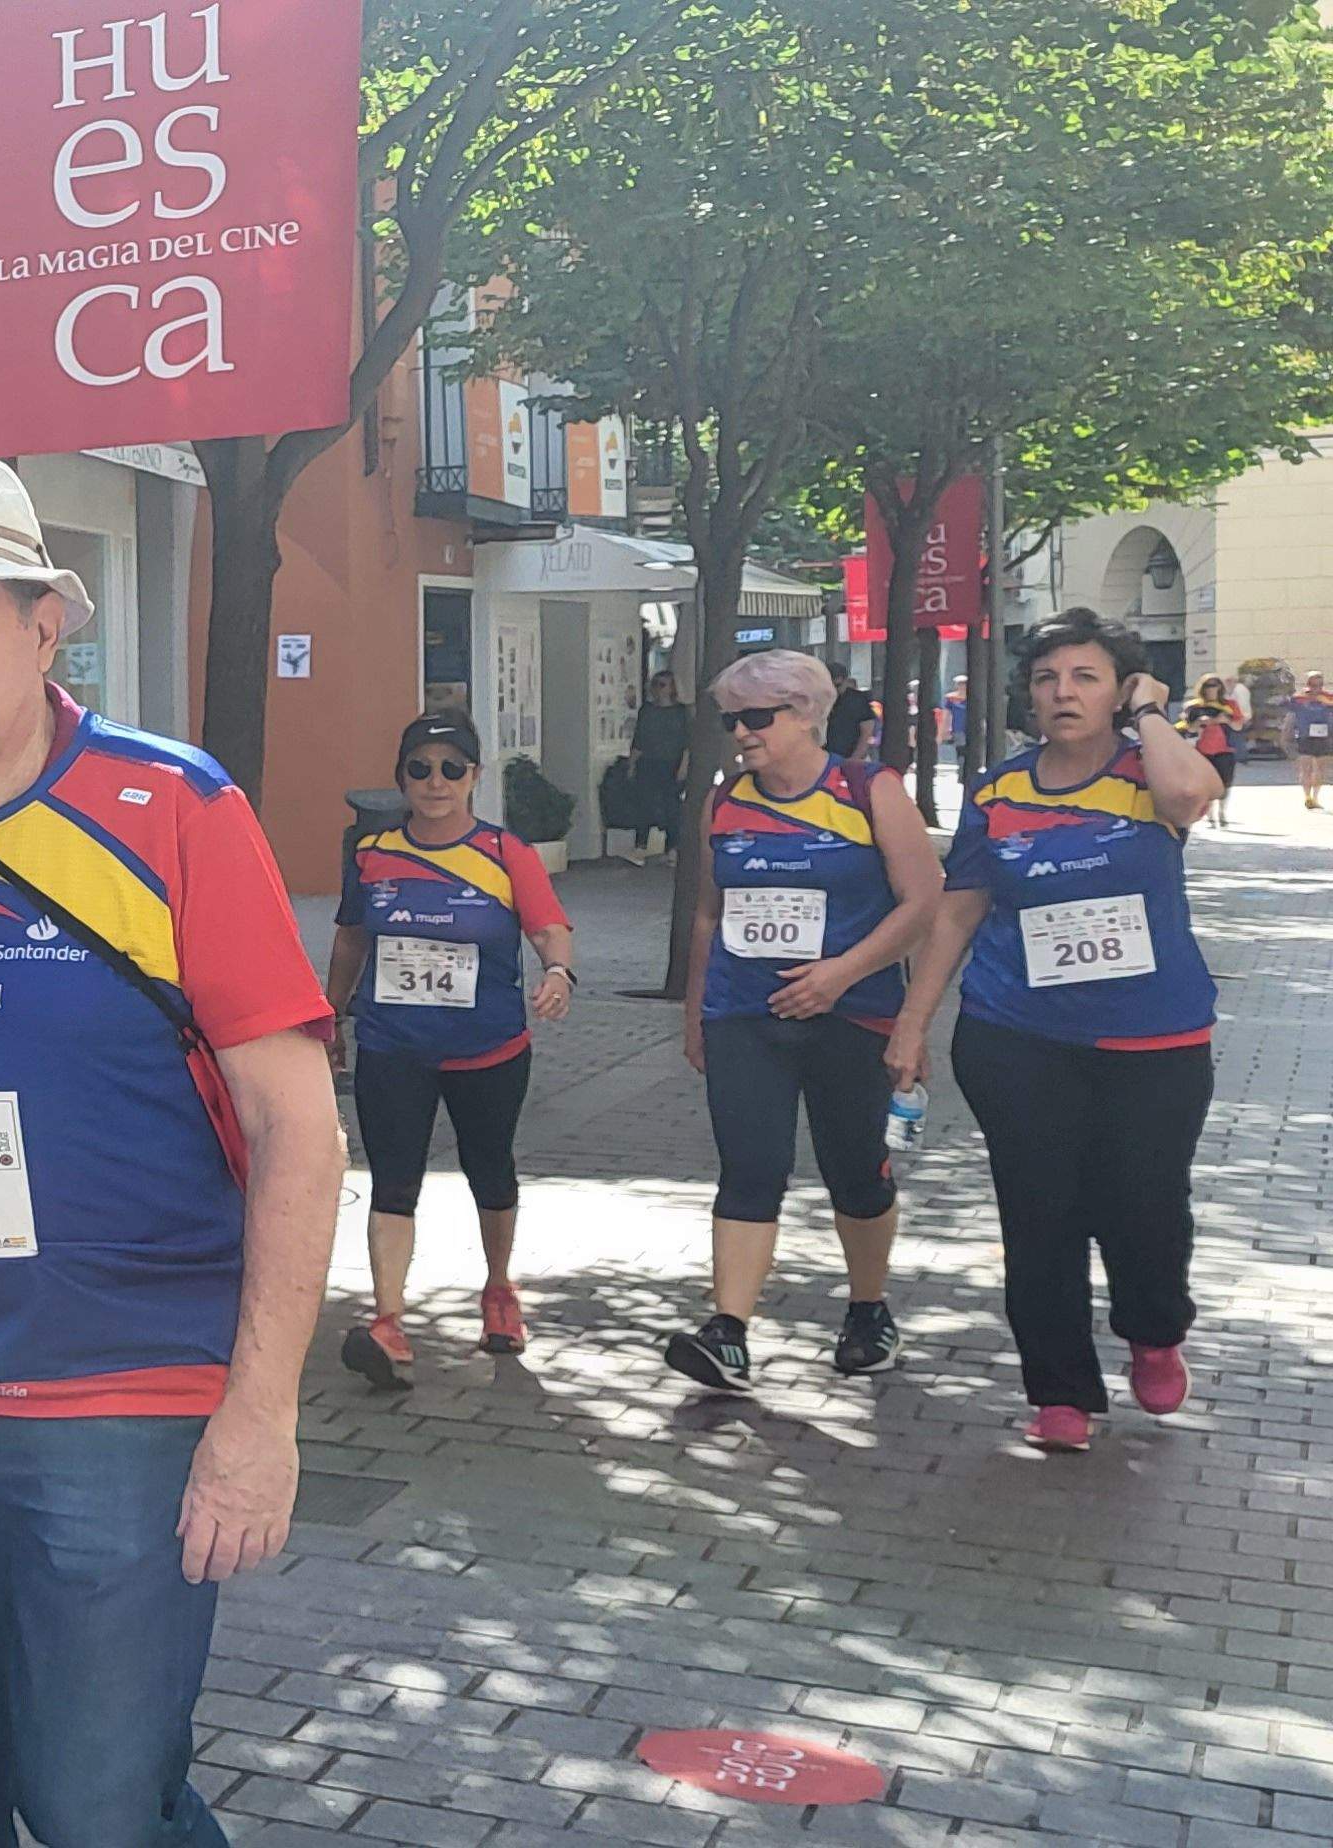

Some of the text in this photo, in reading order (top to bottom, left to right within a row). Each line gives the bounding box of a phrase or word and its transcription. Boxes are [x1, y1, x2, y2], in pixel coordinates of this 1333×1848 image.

[53, 105, 227, 229] es
[54, 275, 234, 386] ca
[743, 922, 800, 943] 600
[1053, 937, 1124, 967] 208
[399, 970, 454, 993] 314
